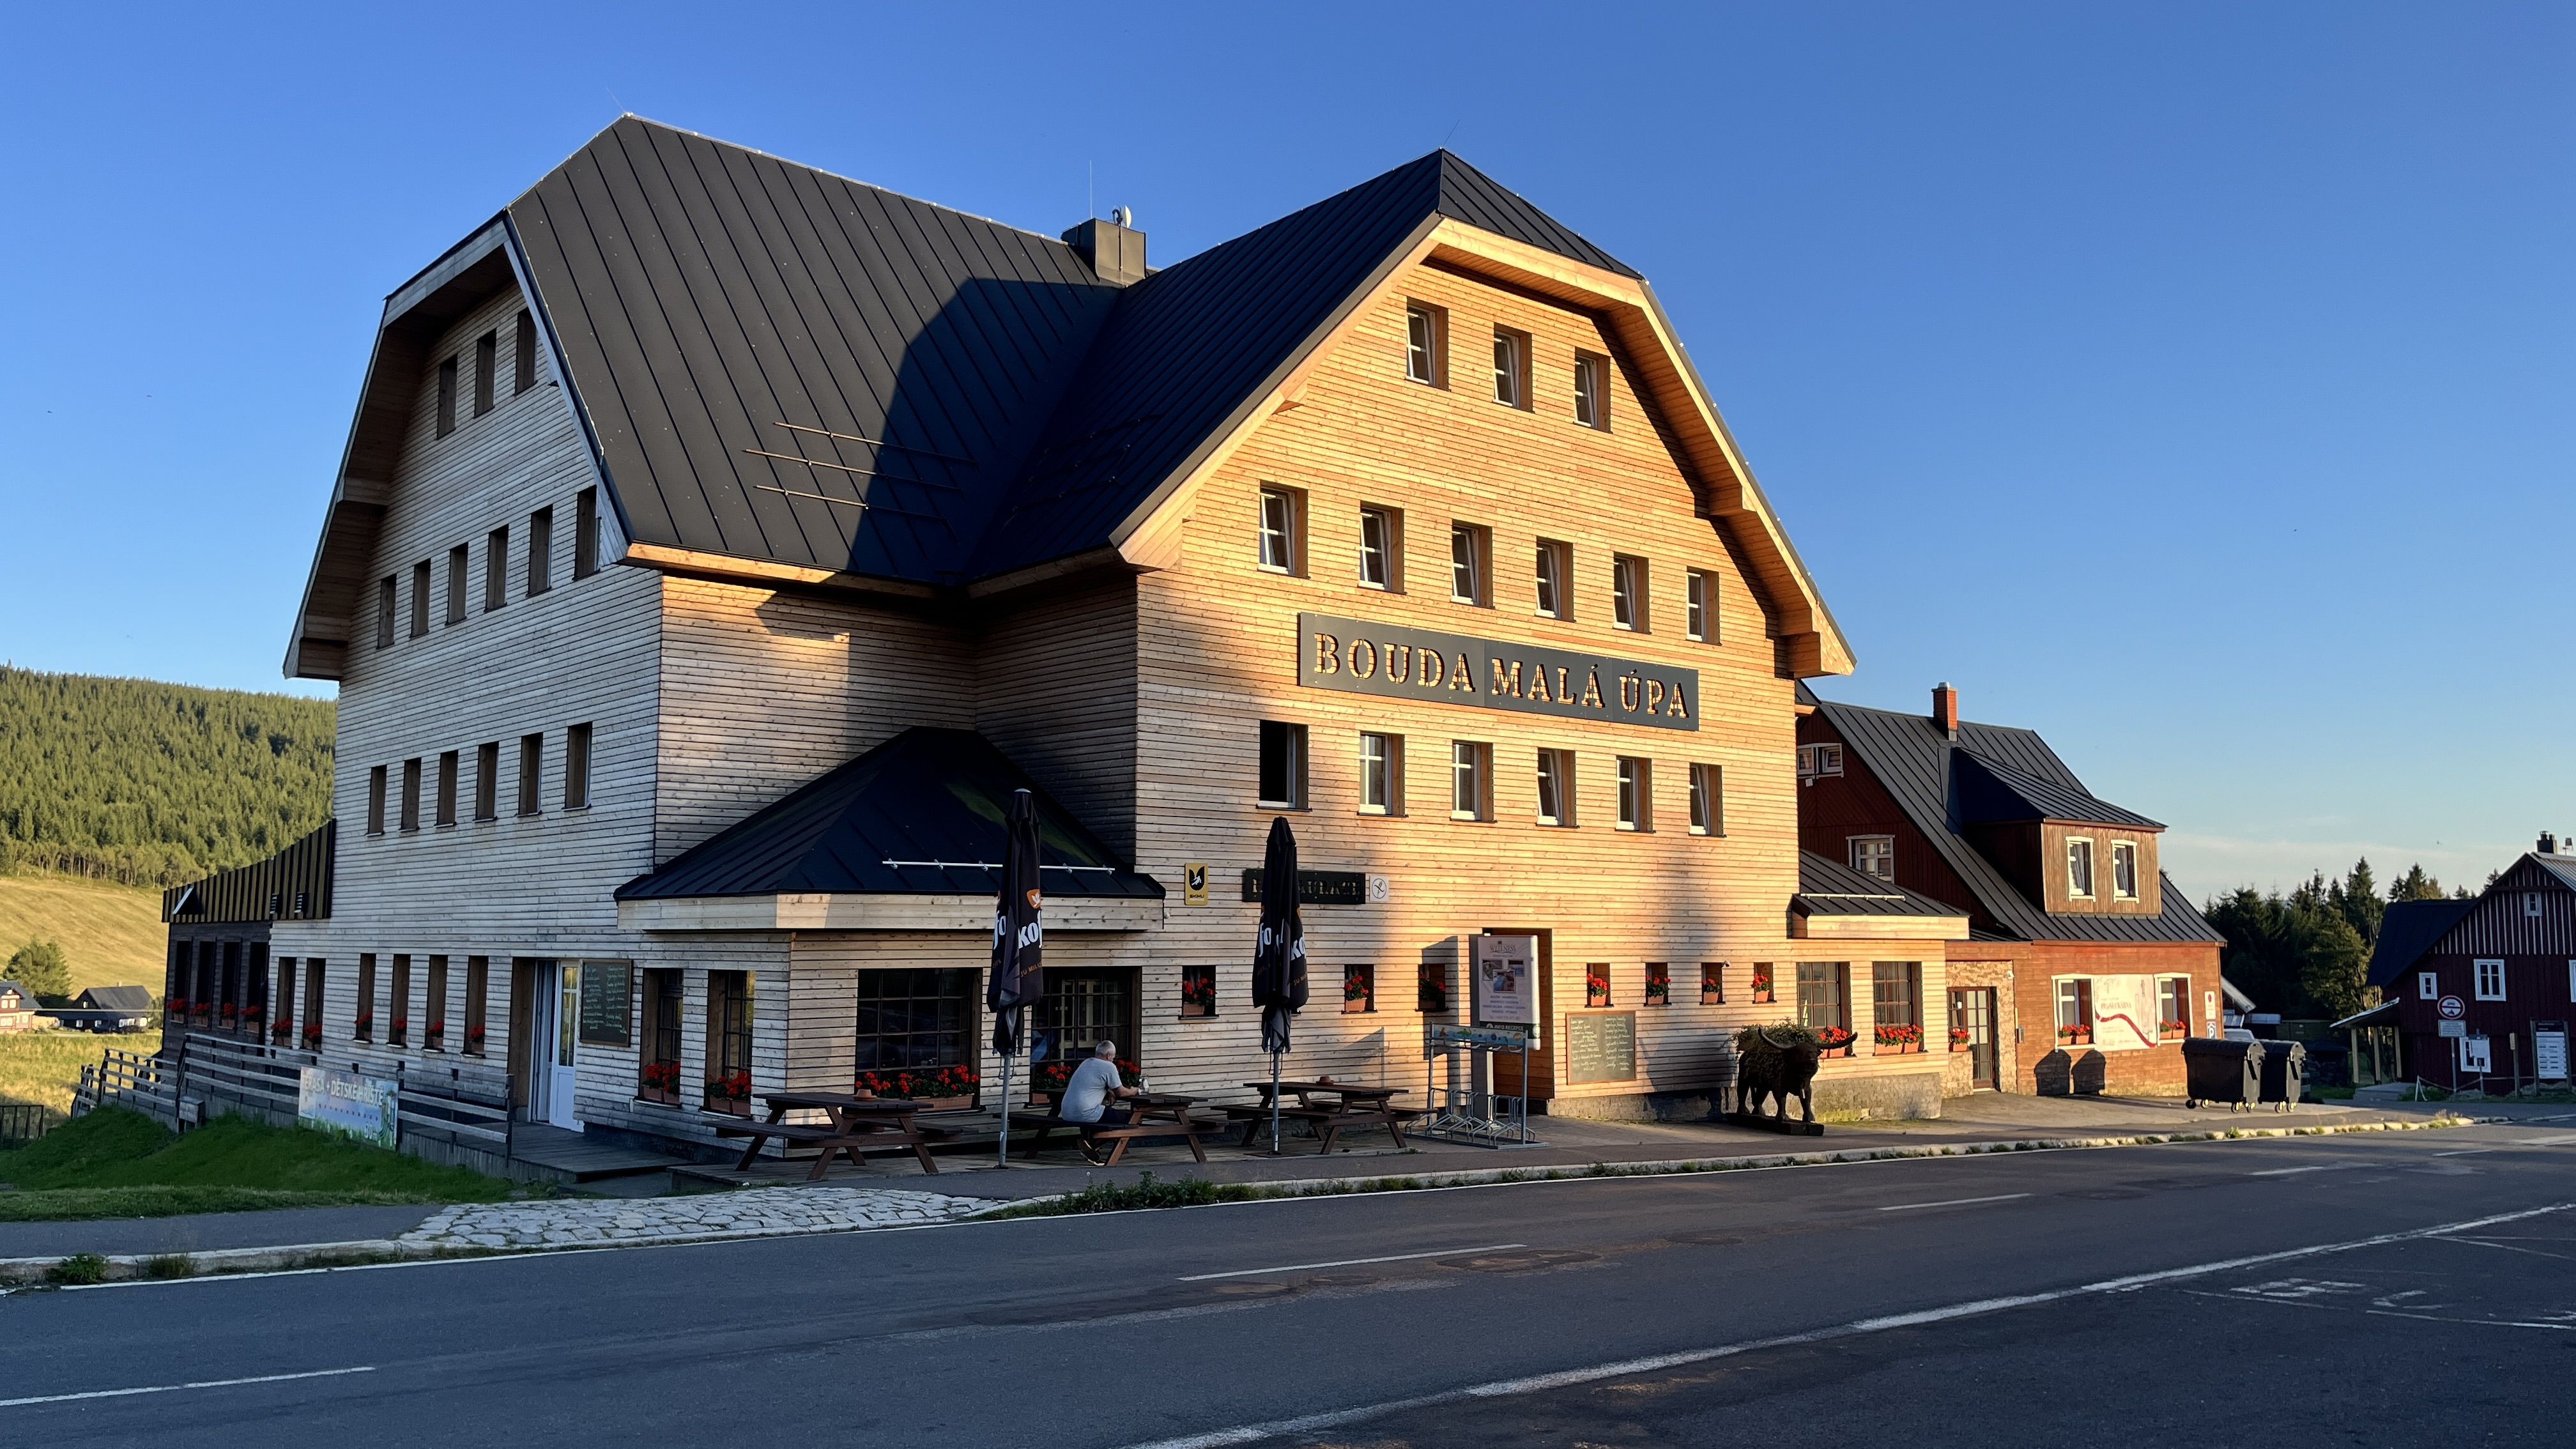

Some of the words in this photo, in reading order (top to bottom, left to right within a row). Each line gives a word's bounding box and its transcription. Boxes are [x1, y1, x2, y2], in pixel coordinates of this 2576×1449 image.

[1314, 632, 1476, 693] BOUDA
[1491, 657, 1606, 709] MALÁ
[1619, 669, 1690, 719] ÚPA
[1252, 878, 1360, 895] RAURACE
[302, 1075, 325, 1092] TERASA
[331, 1078, 356, 1100] DĚTSKÉ
